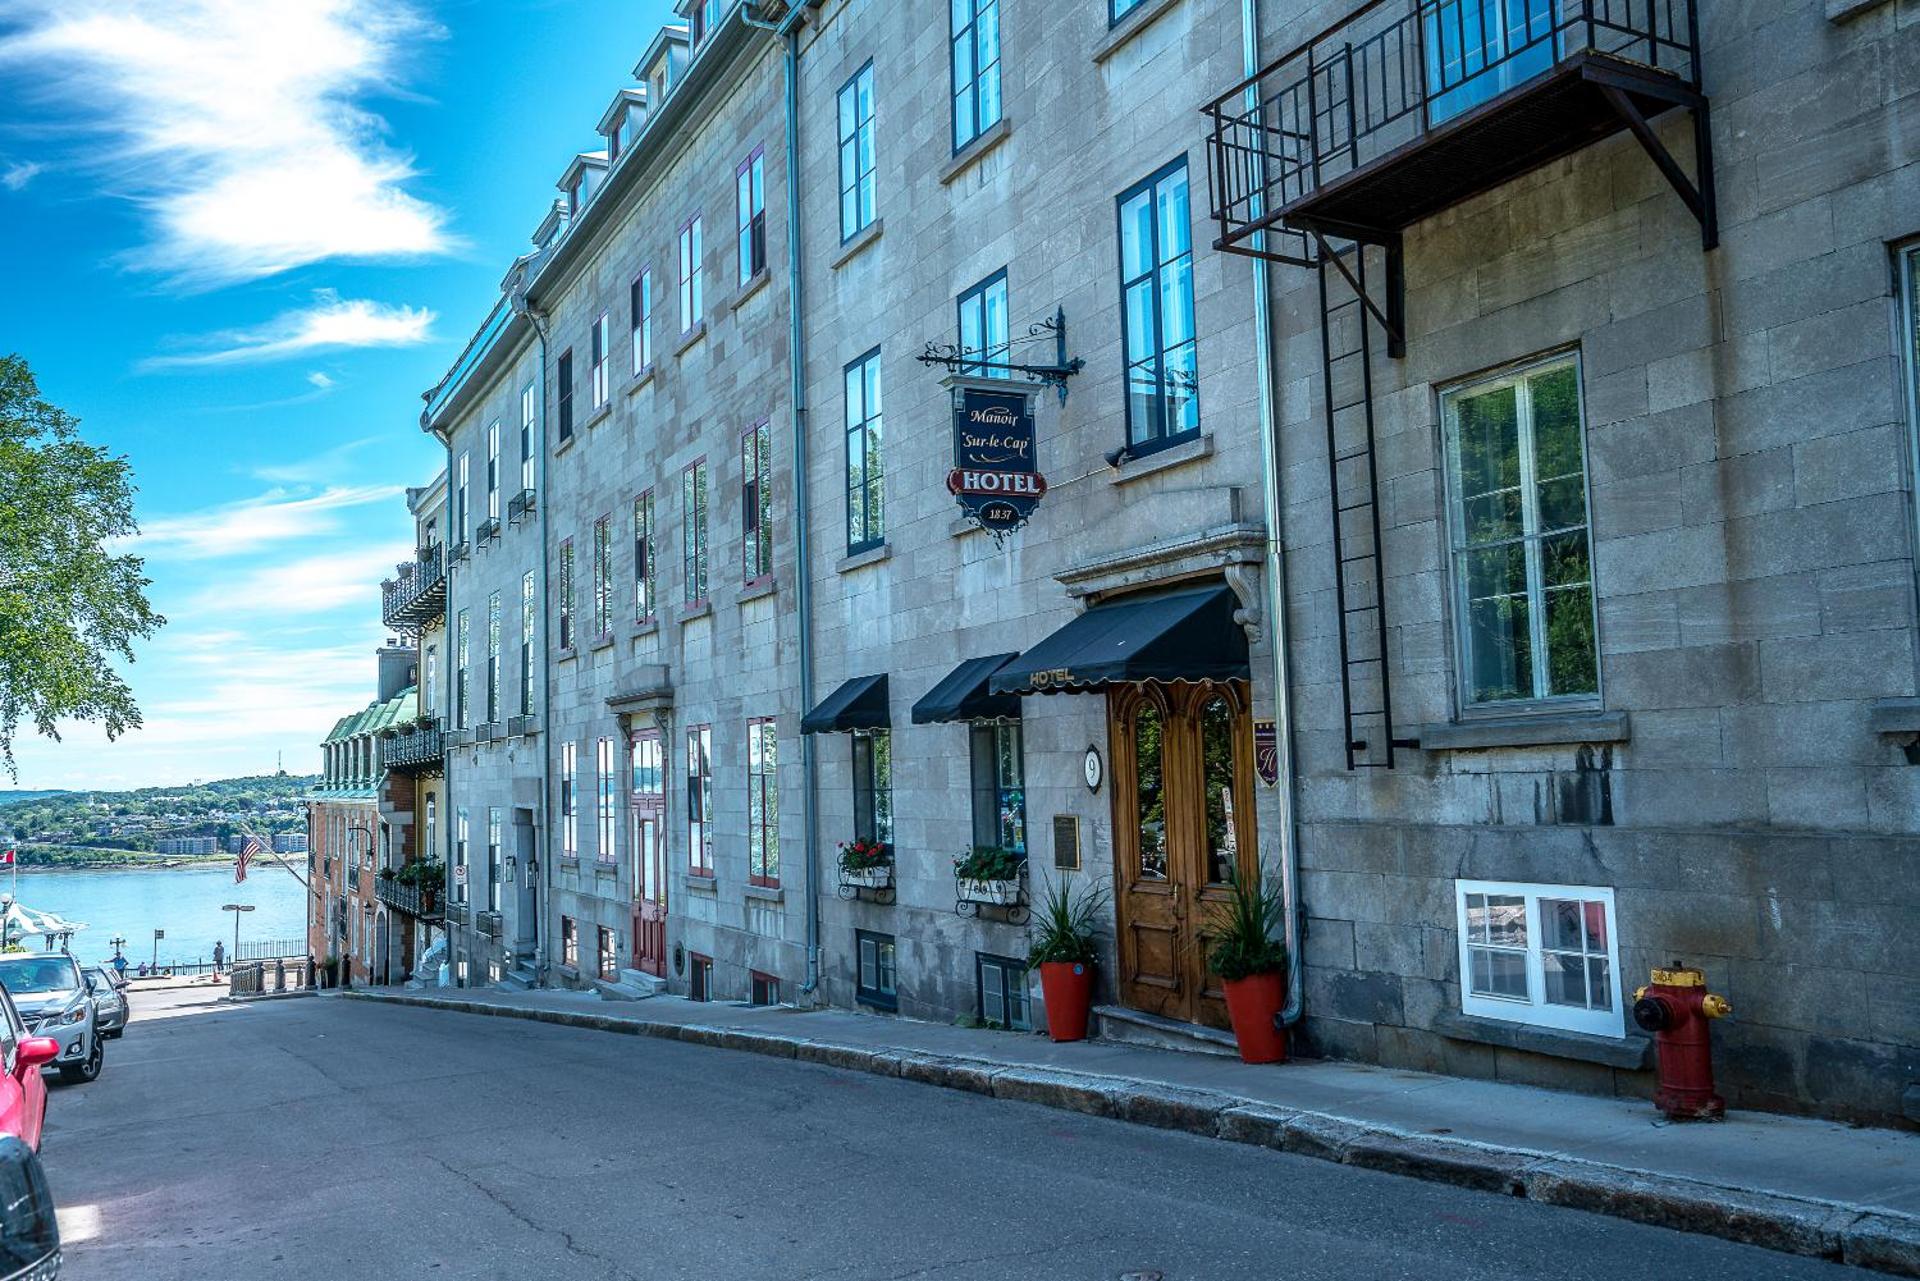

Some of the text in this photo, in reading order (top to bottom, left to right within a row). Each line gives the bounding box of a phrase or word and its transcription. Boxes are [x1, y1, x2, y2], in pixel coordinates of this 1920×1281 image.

[970, 408, 1019, 427] Manoir
[963, 471, 1040, 493] HOTEL
[989, 509, 1012, 520] 1837
[1029, 667, 1075, 686] HOTEL
[1088, 758, 1095, 779] 9
